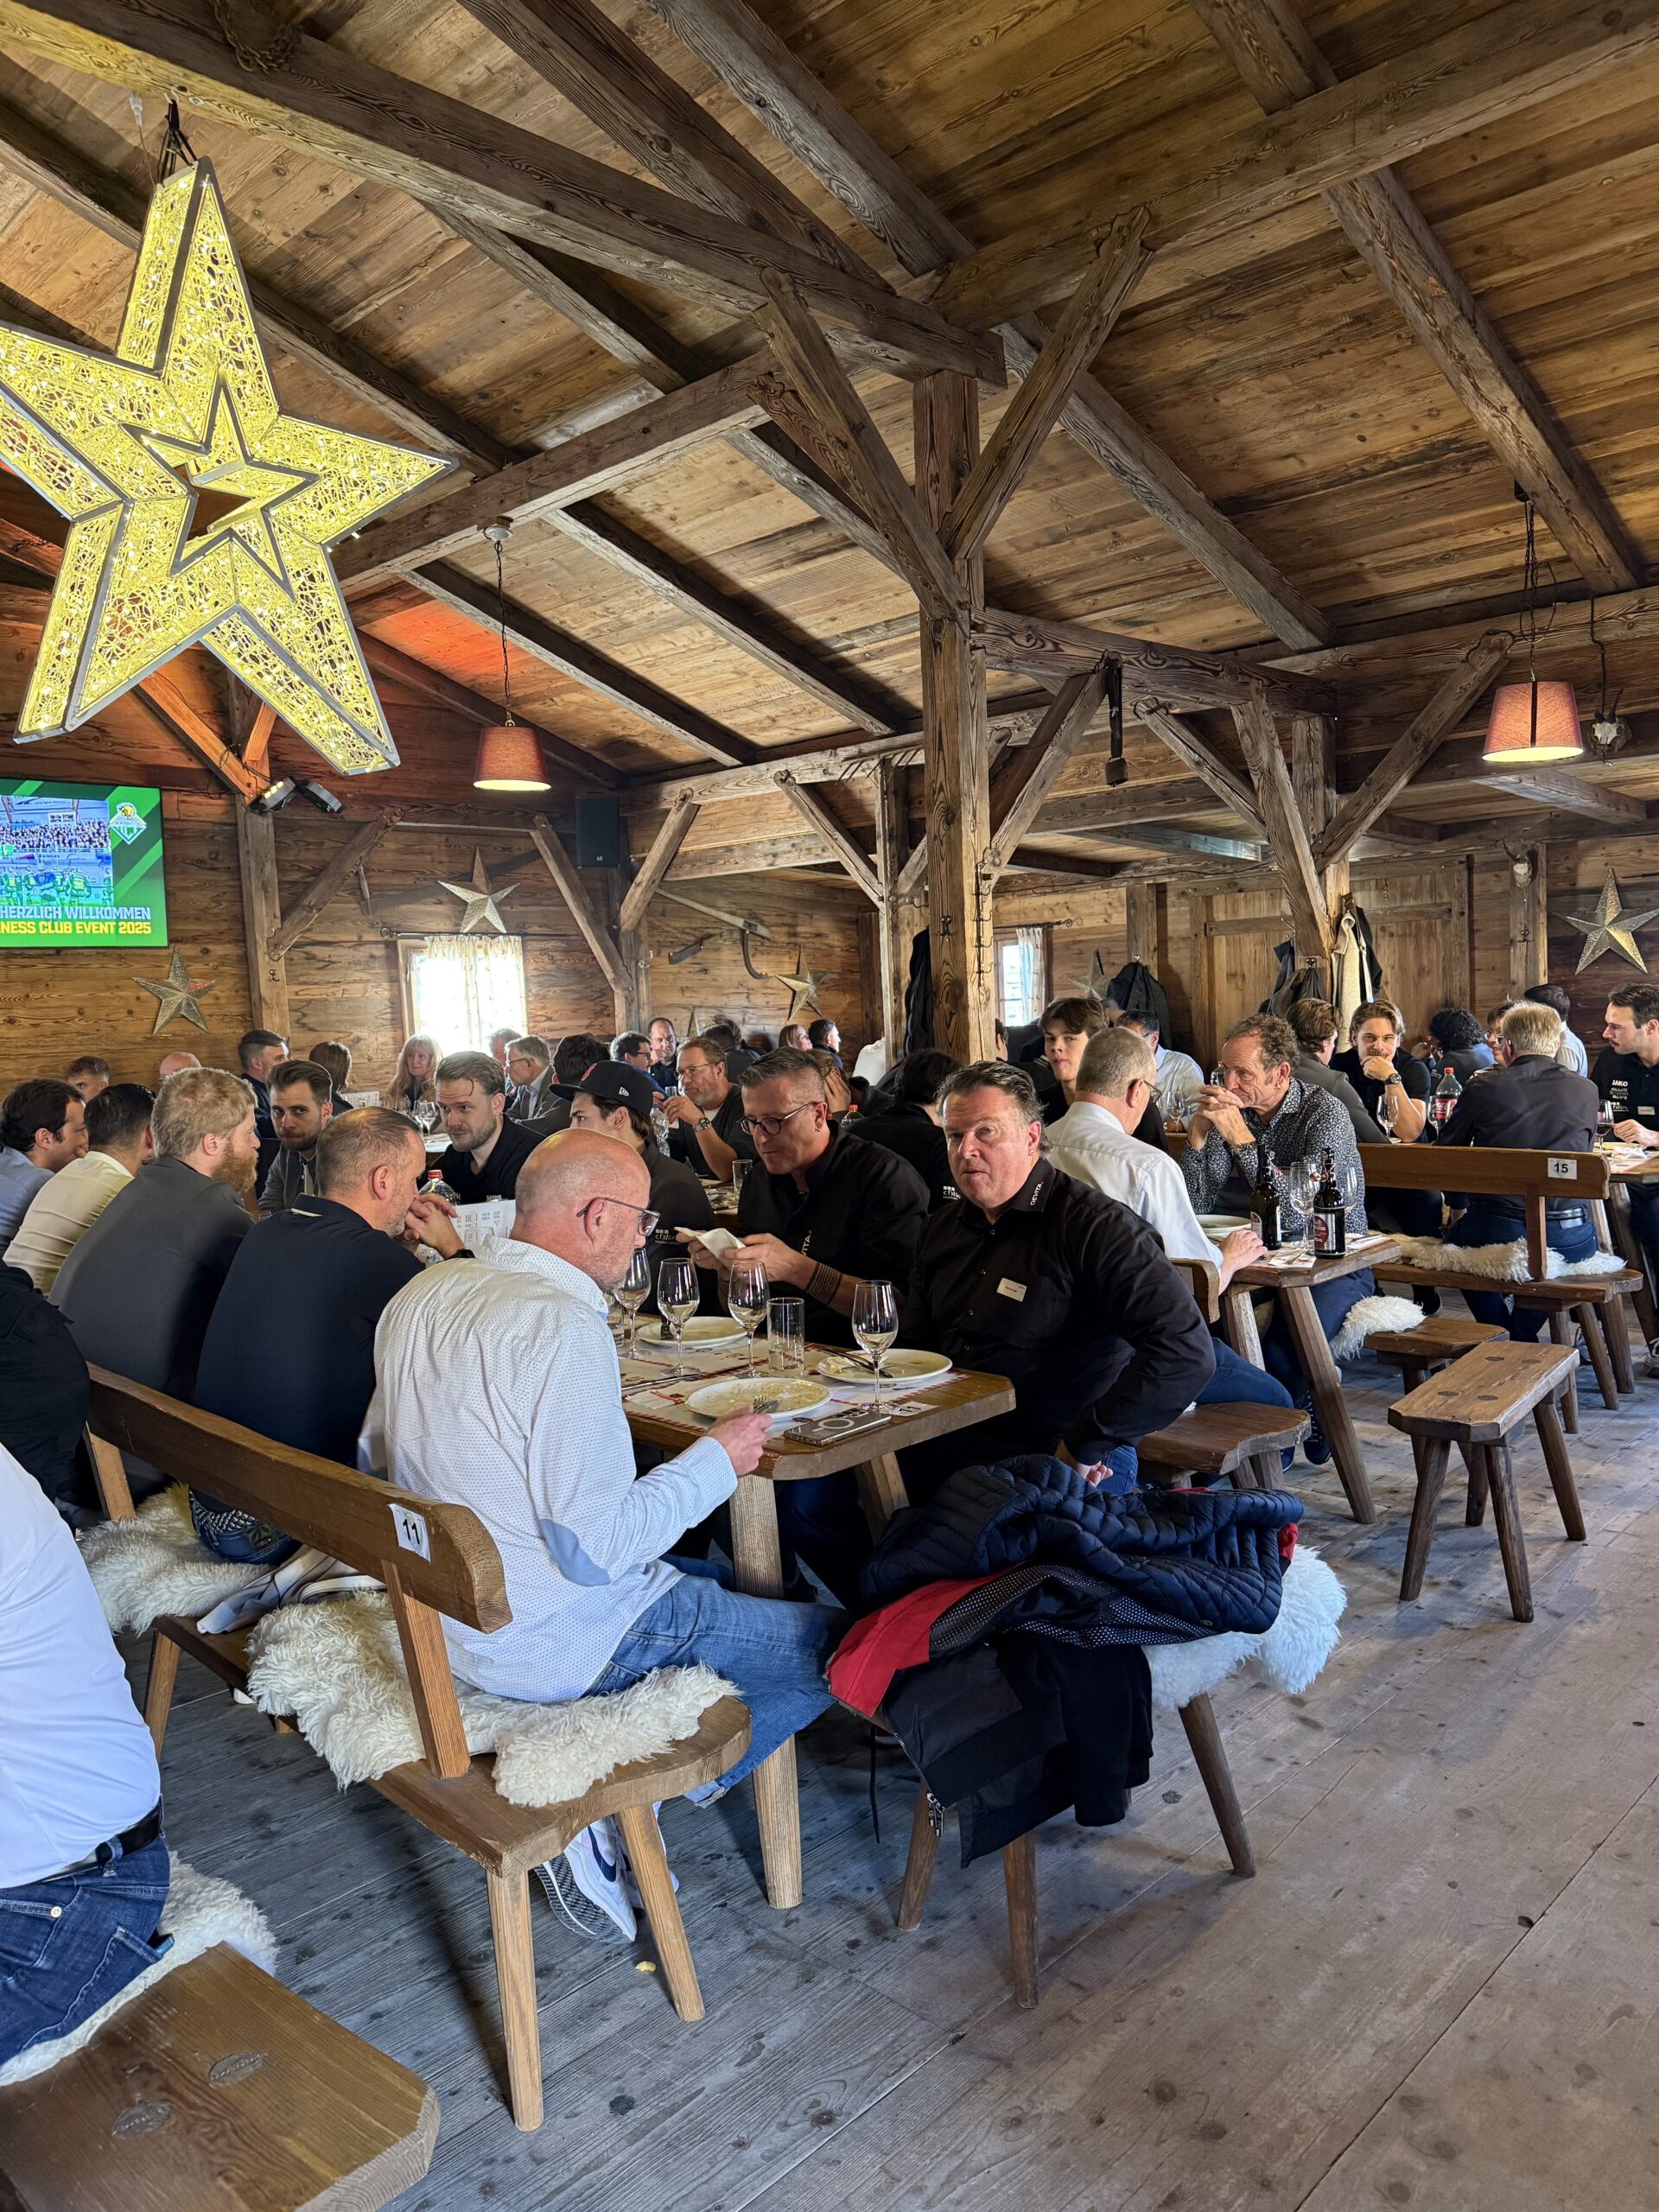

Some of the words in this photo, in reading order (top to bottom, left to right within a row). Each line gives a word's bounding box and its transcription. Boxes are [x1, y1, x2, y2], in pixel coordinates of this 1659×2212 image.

[0, 906, 62, 919] HERZLICH
[66, 906, 151, 920] WILLKOMMEN
[39, 921, 72, 934] CLUB
[76, 921, 116, 934] EVENT
[118, 921, 151, 934] 2025
[1554, 1162, 1568, 1173] 15
[403, 1518, 421, 1545] 11
